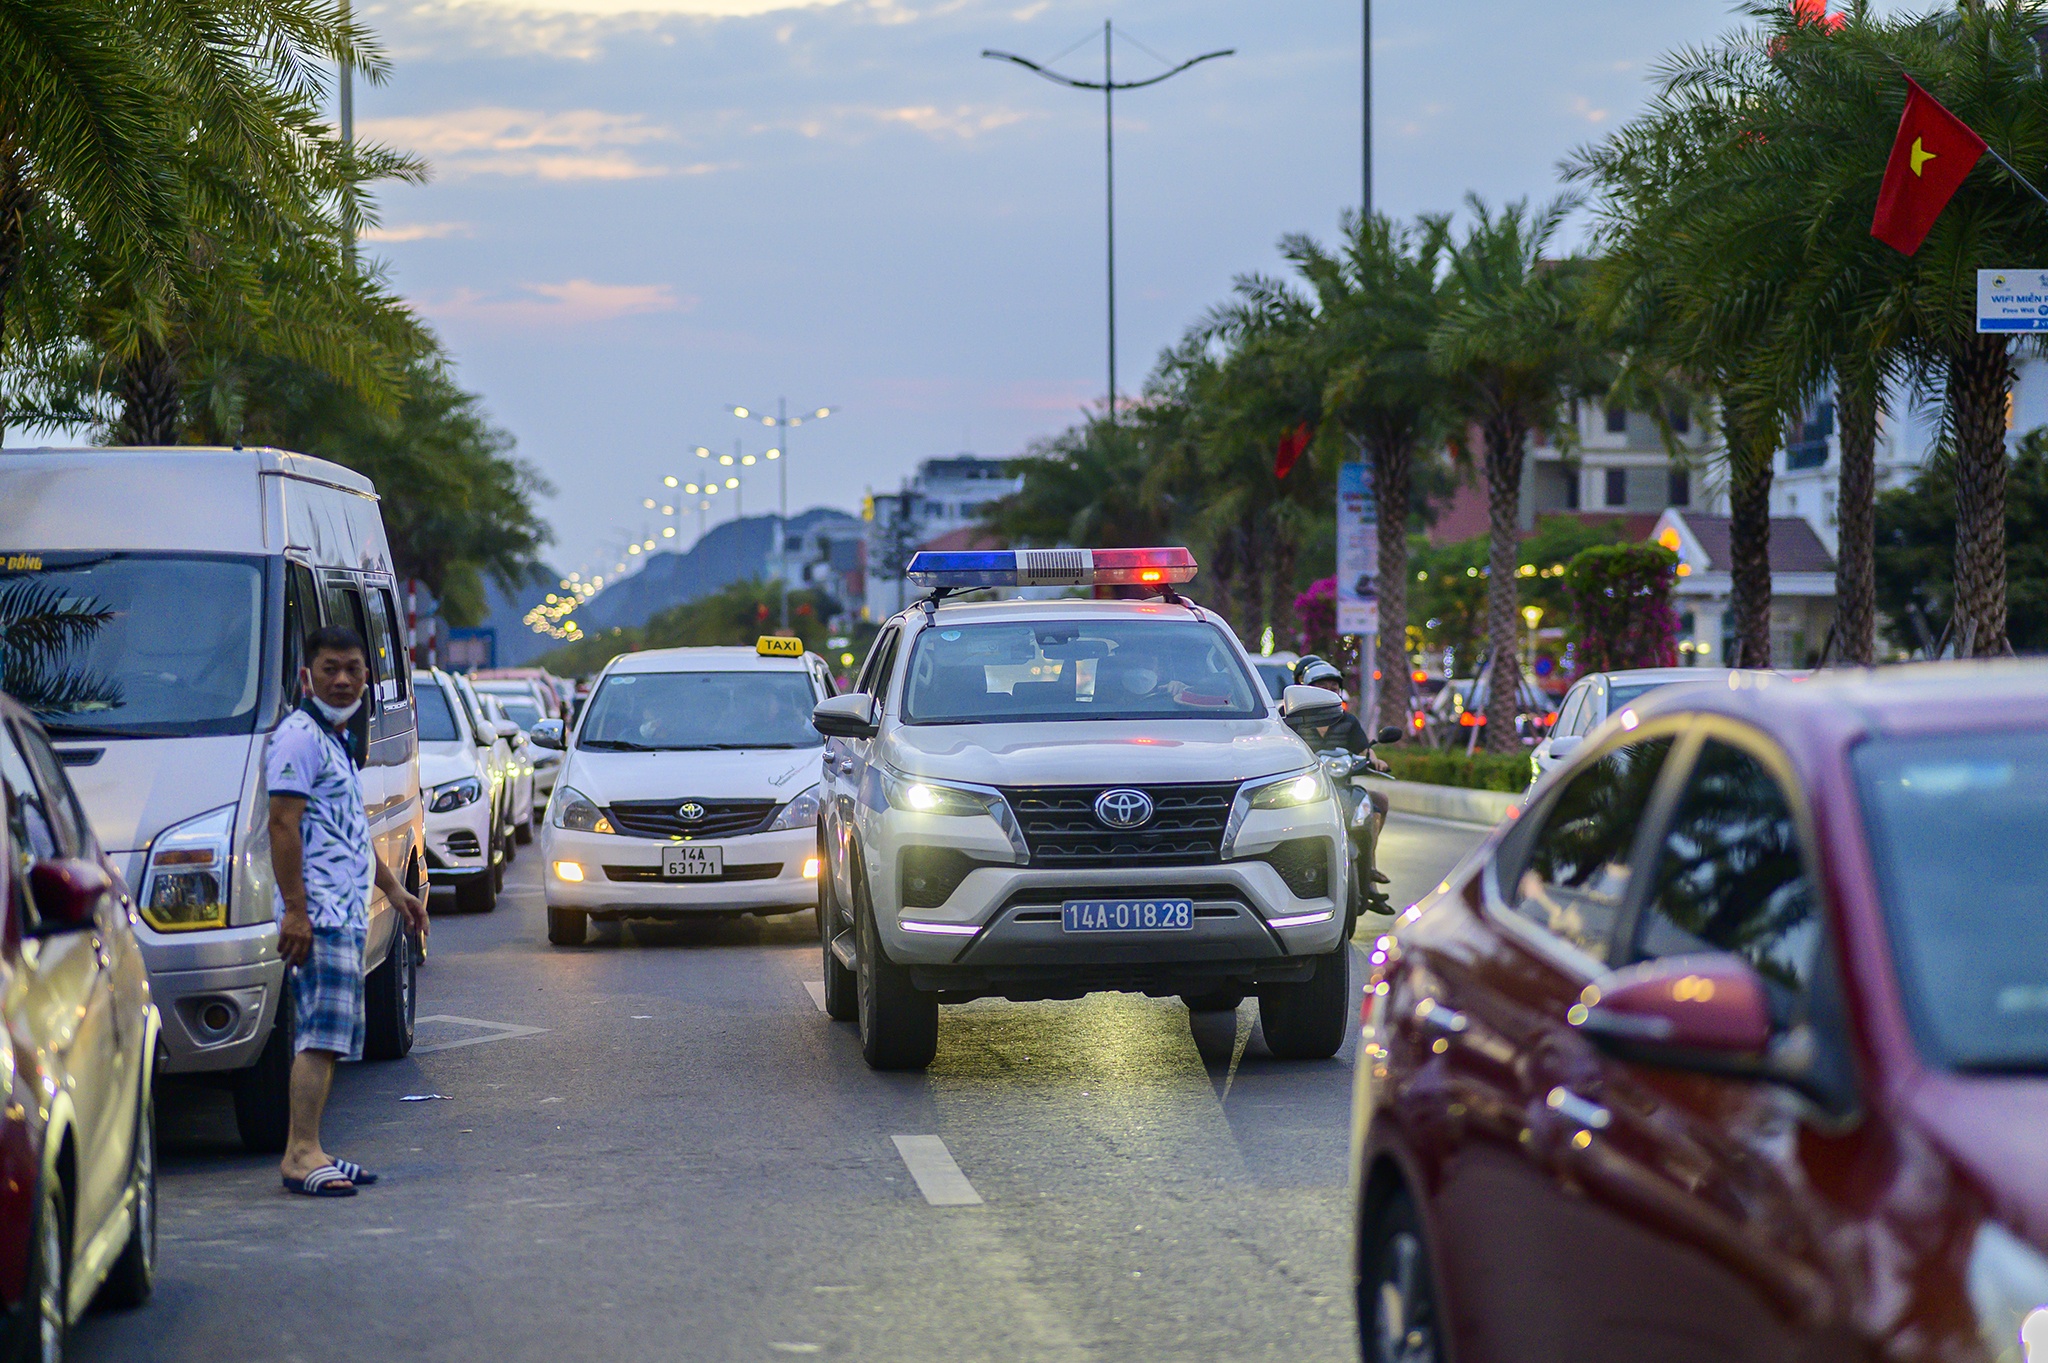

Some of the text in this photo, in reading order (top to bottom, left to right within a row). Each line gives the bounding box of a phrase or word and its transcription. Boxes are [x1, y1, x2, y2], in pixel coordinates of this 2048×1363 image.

[1991, 295, 2014, 303] WIFI
[765, 640, 796, 651] TAXI
[681, 848, 705, 860] 14A
[669, 862, 714, 874] 631.71
[1070, 902, 1189, 929] 14A-018.28
